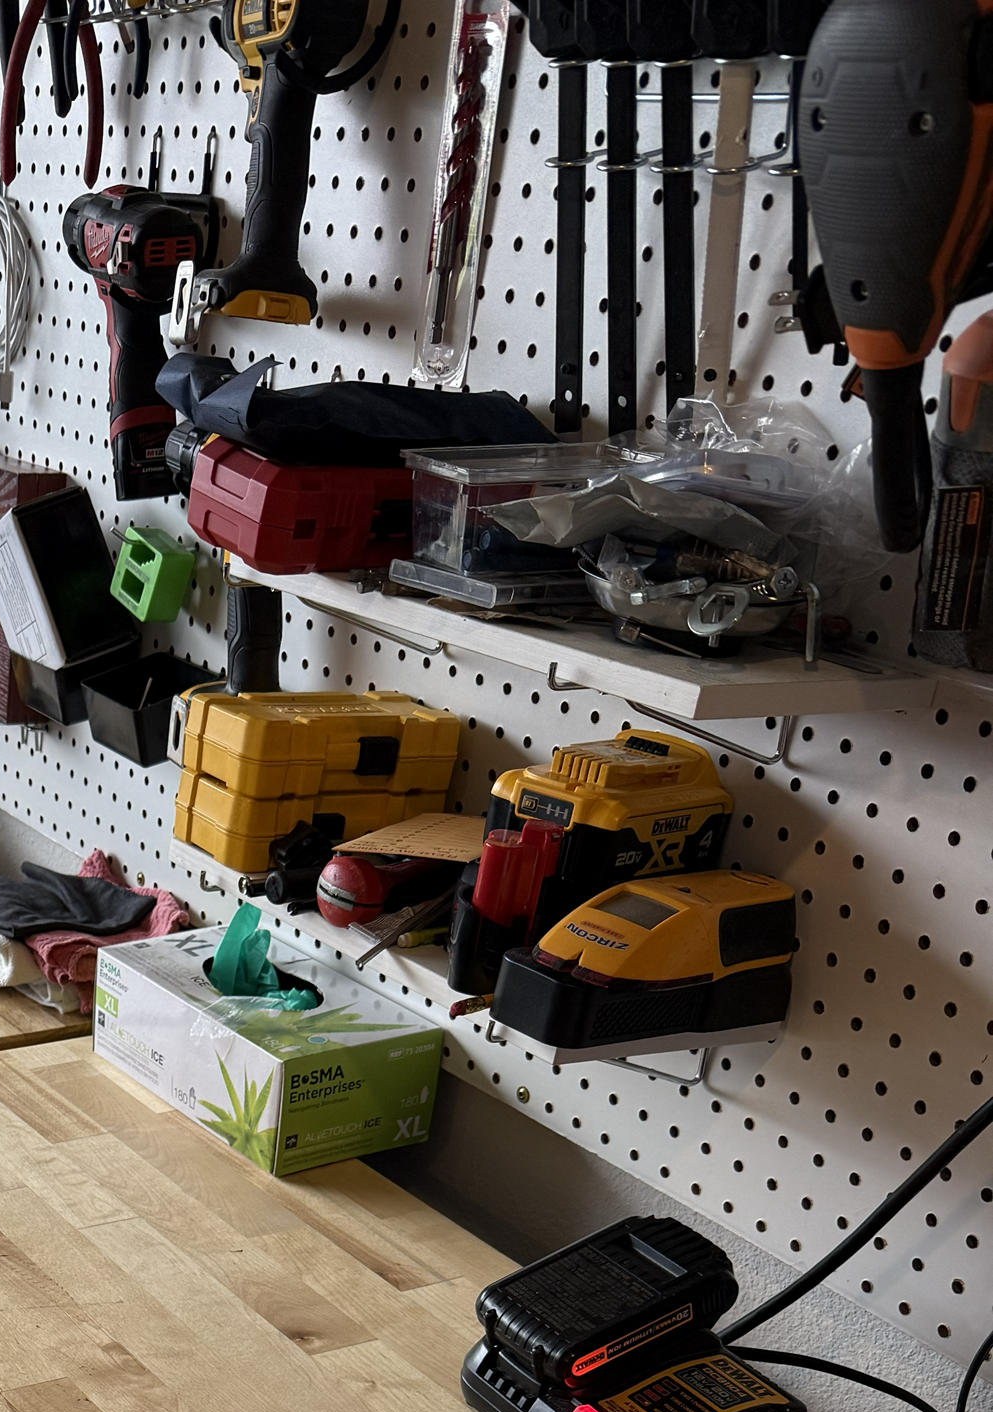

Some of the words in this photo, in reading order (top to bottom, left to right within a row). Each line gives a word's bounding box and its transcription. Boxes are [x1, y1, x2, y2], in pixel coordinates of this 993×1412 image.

[651, 815, 691, 836] DEWALT
[698, 830, 712, 848] 4
[417, 850, 458, 859] PLEASE
[633, 836, 686, 877] XR
[164, 934, 214, 957] XL
[566, 922, 629, 950] ZIRCON
[191, 976, 210, 988] ICE
[103, 994, 116, 1015] XL
[150, 1048, 164, 1066] ICE
[174, 1087, 188, 1105] 180
[289, 1080, 363, 1104] Enterprises
[401, 1096, 418, 1108] 180
[364, 1117, 381, 1128] ICE
[392, 1115, 426, 1142] XL
[608, 1342, 622, 1354] ION
[574, 1352, 606, 1372] DEWALT
[681, 1373, 714, 1395] LITHIUM
[709, 1394, 727, 1404] ION
[702, 1366, 746, 1398] DCB1104
[710, 1359, 776, 1399] DEWALT
